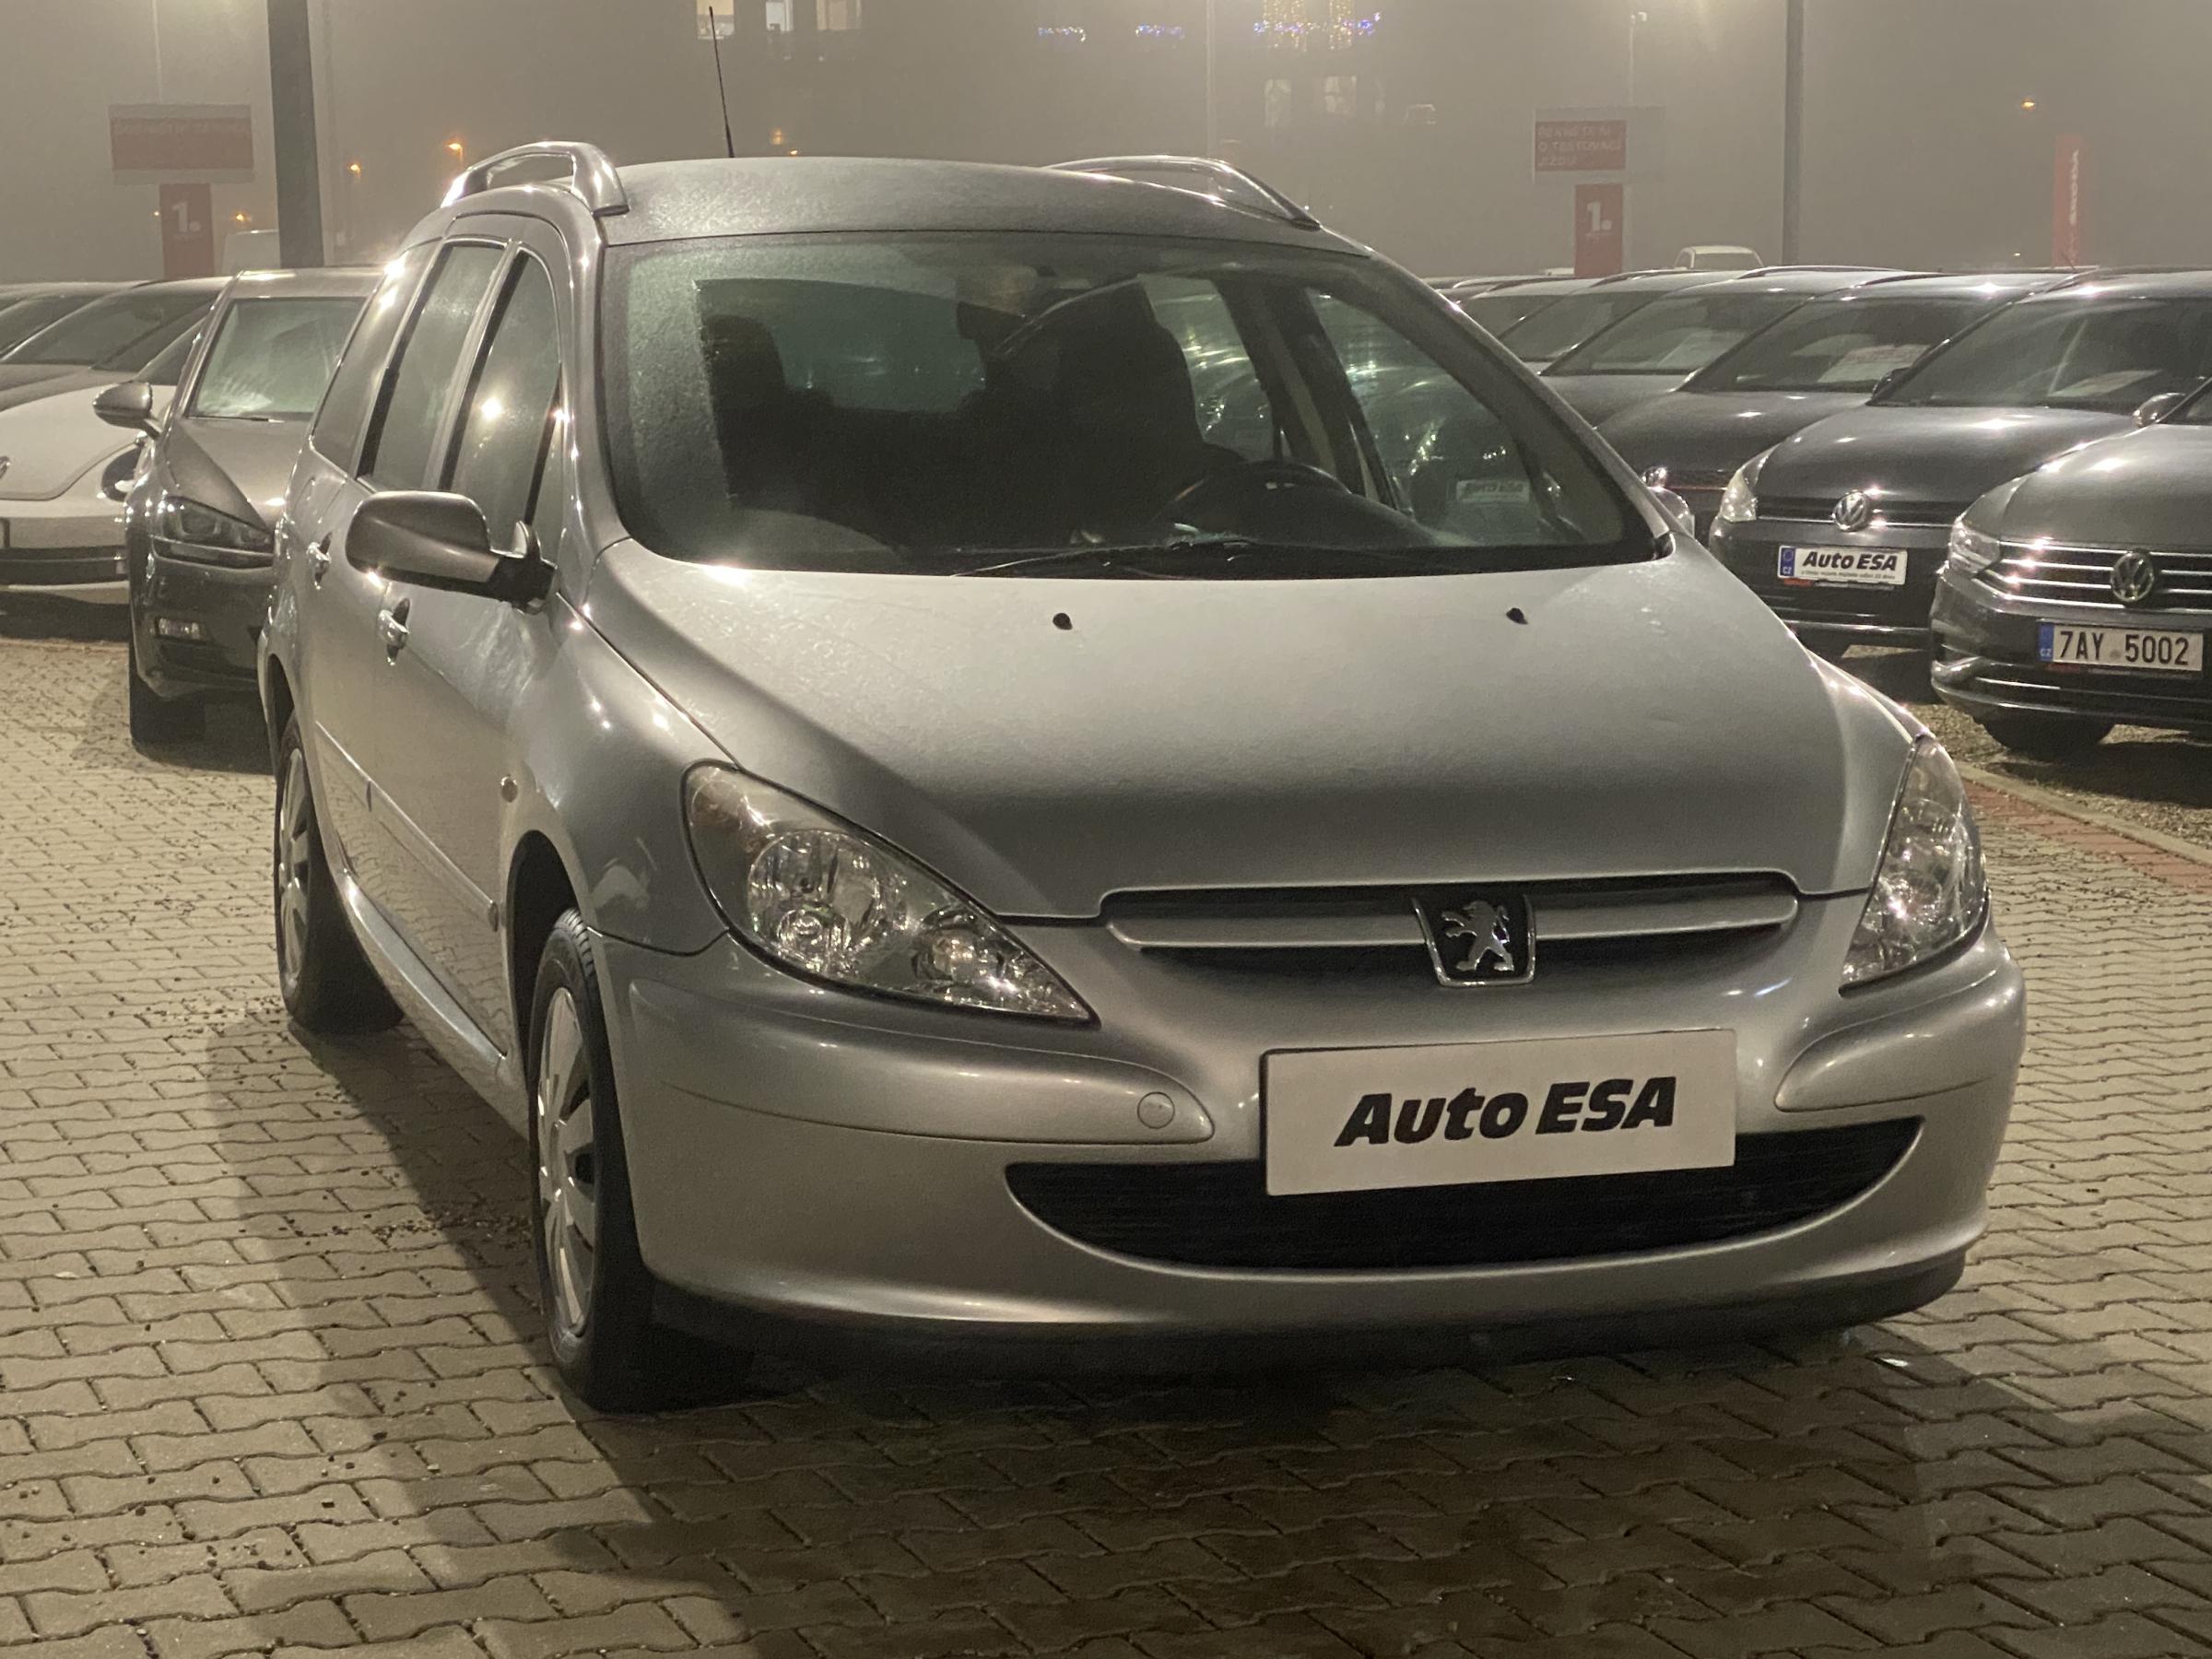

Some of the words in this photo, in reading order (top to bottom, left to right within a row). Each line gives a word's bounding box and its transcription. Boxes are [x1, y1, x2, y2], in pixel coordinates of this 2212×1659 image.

[171, 200, 201, 232] 1.
[1586, 199, 1613, 231] 1.
[1783, 566, 1792, 575] CZ
[1803, 551, 1854, 570] Auto
[1856, 553, 1899, 571] ESA
[2040, 648, 2052, 657] CZ
[2060, 630, 2104, 660] 7AY
[2125, 634, 2189, 665] 5002
[1334, 1088, 1528, 1147] Auto
[1535, 1077, 1677, 1135] ESA
